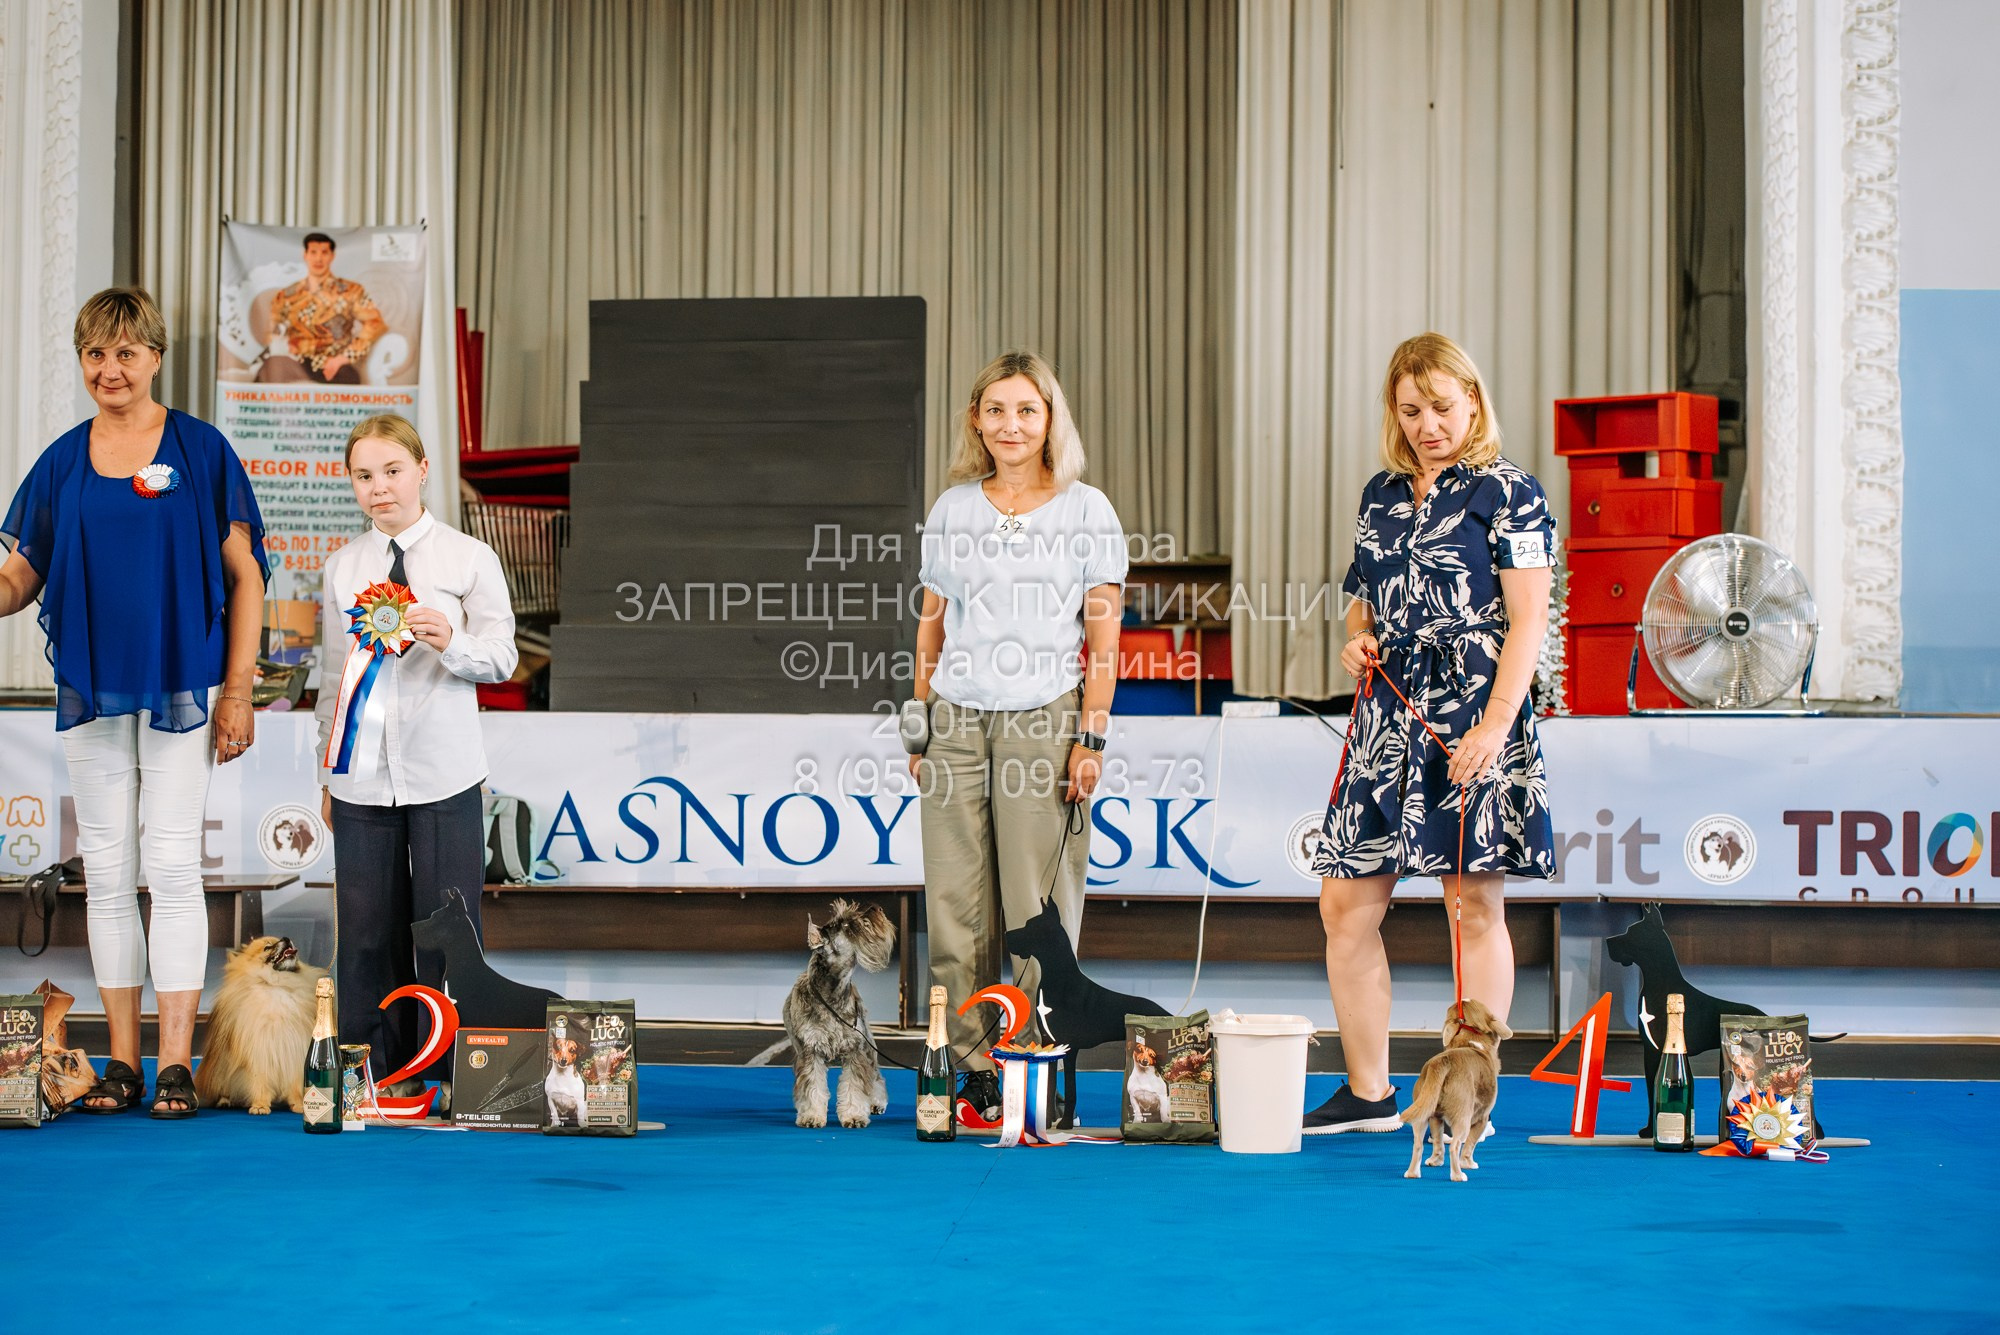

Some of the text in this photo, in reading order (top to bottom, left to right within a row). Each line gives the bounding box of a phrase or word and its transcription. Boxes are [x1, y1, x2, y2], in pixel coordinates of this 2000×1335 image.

[225, 390, 414, 405] УНИКАЛЬНАЯ ВОЗМОЖНОСТЬ
[590, 1026, 626, 1041] LUCY
[1764, 1041, 1804, 1058] LUCY
[1530, 991, 1632, 1138] 4
